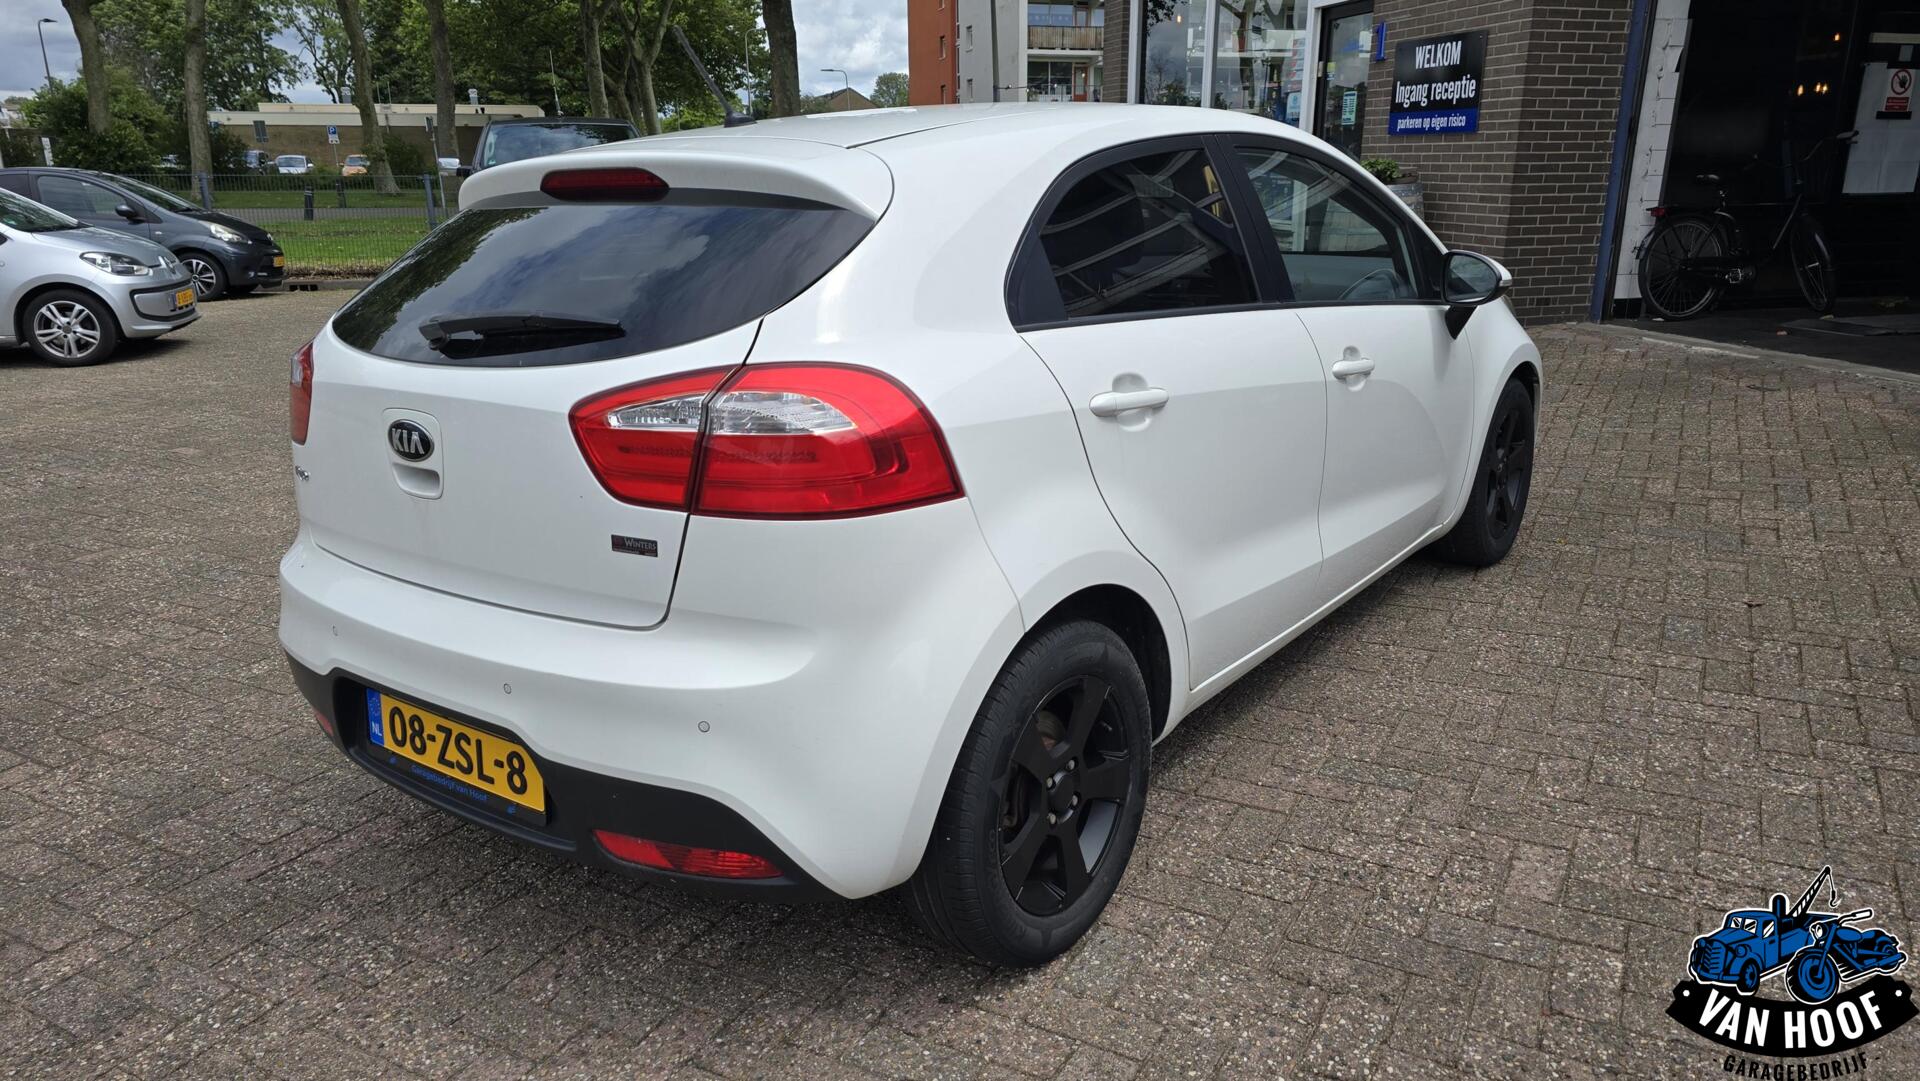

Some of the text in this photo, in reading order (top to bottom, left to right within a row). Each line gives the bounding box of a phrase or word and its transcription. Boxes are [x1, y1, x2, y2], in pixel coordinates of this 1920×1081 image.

[1415, 40, 1462, 69] WELKOM
[1395, 74, 1476, 108] Ingang receptie
[1397, 113, 1466, 132] parkeren op eigen risico
[391, 428, 425, 454] KIA
[371, 723, 383, 737] NL
[389, 706, 528, 795] 08-ZSL-8
